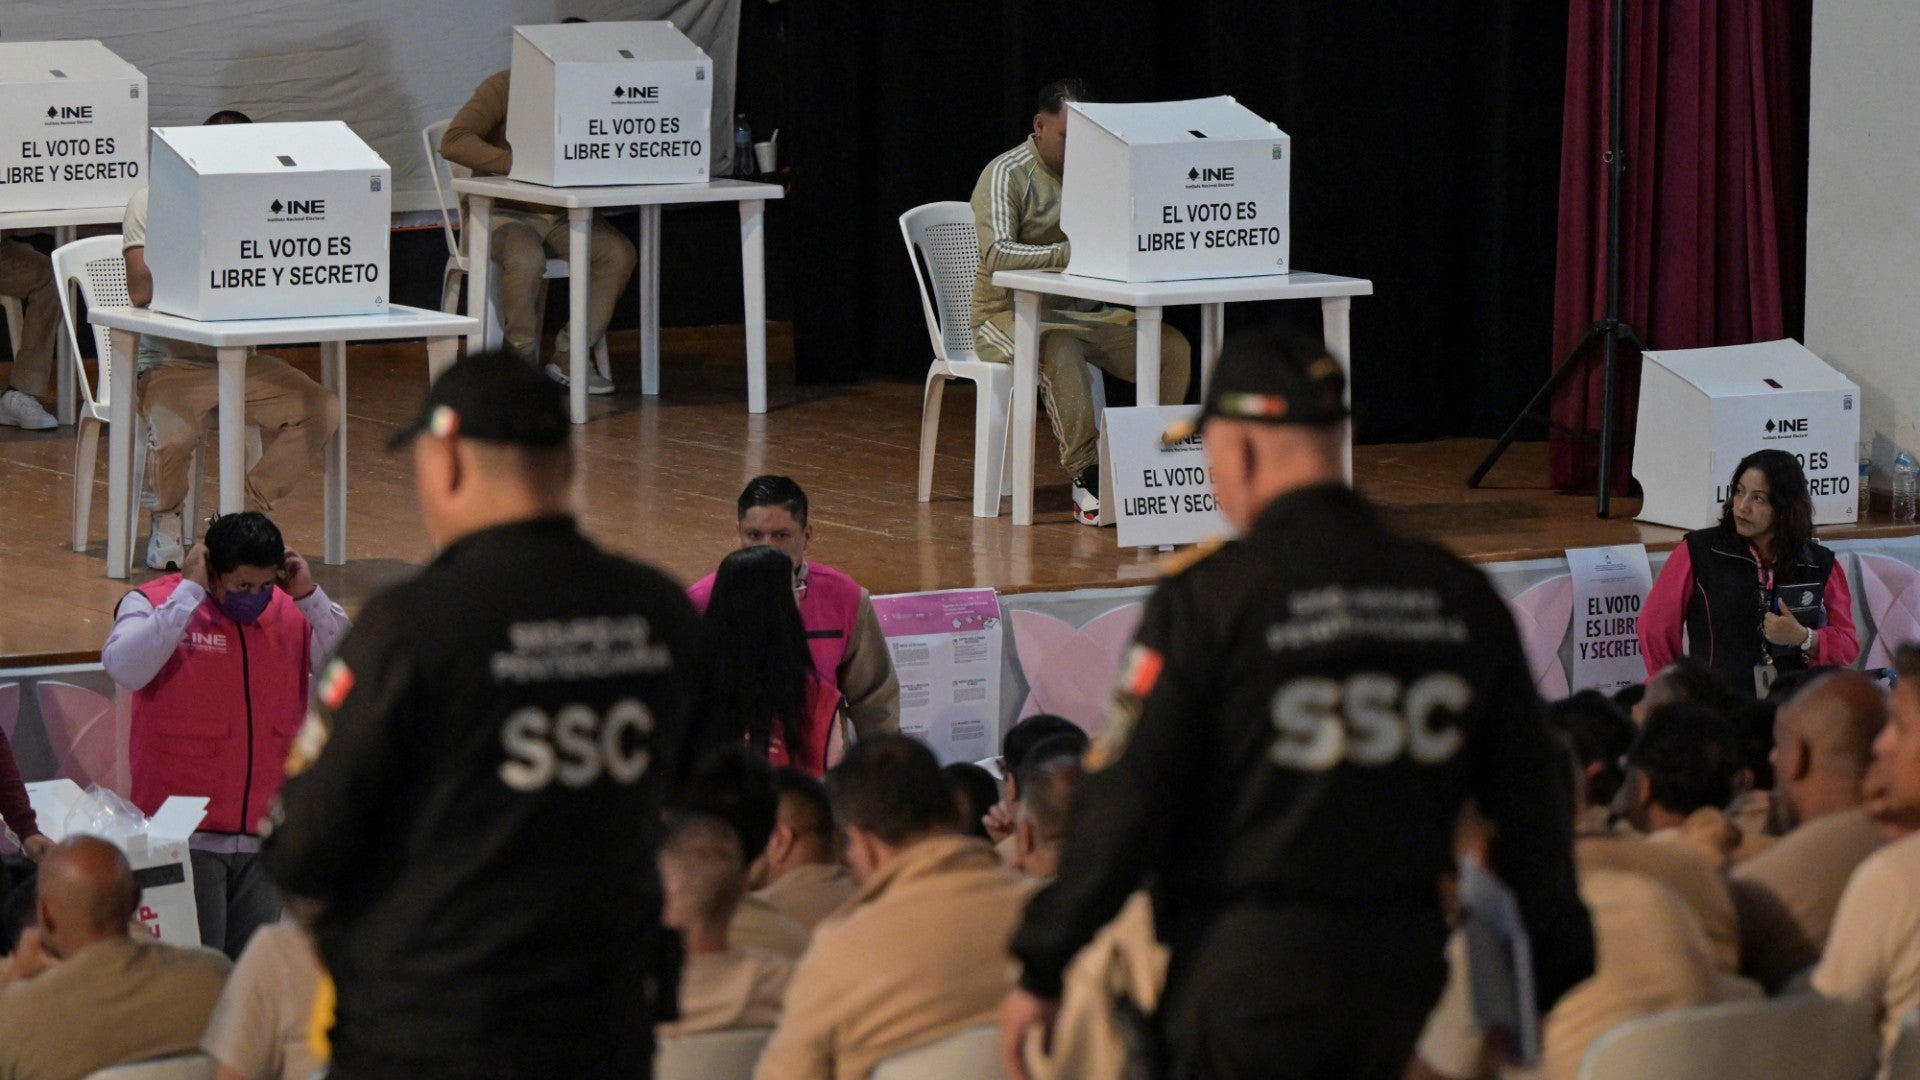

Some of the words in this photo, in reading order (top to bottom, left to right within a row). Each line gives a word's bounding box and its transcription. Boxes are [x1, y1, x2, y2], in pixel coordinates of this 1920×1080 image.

[628, 86, 659, 99] INE
[61, 105, 93, 119] INE
[588, 119, 609, 136] EL
[612, 117, 656, 135] VOTO
[660, 117, 680, 134] ES
[22, 141, 42, 158] EL
[46, 138, 90, 157] VOTO
[95, 137, 115, 155] ES
[564, 142, 611, 160] LIBRE
[616, 142, 625, 159] Y
[629, 140, 702, 159] SECRETO
[48, 165, 60, 182] Y
[63, 161, 139, 182] SECRETO
[1202, 167, 1235, 181] INE
[287, 199, 325, 215] INE
[1162, 205, 1183, 224] EL
[1187, 202, 1232, 223] VOTO
[1236, 201, 1257, 220] ES
[240, 240, 264, 260] EL
[269, 237, 322, 258] VOTO
[327, 236, 351, 256] ES
[1138, 231, 1186, 252] LIBRE
[1190, 231, 1201, 249] Y
[1204, 226, 1280, 248] SECRETO
[210, 267, 266, 289] LIBRE
[272, 267, 285, 286] Y
[289, 263, 379, 286] SECRETO
[1778, 418, 1808, 432] INE
[1810, 451, 1828, 470] ES
[1143, 469, 1162, 487] EL
[1165, 467, 1205, 486] VOTO
[1806, 476, 1850, 496] RETO
[1124, 496, 1168, 516] LIBRE
[1170, 495, 1180, 514] Y
[1588, 598, 1603, 615] EL
[1605, 595, 1640, 614] VOTO
[192, 632, 227, 646] INE
[1586, 620, 1601, 638] ES
[1580, 642, 1588, 660] Y
[1270, 673, 1470, 771] SSC
[499, 699, 653, 791] SSC
